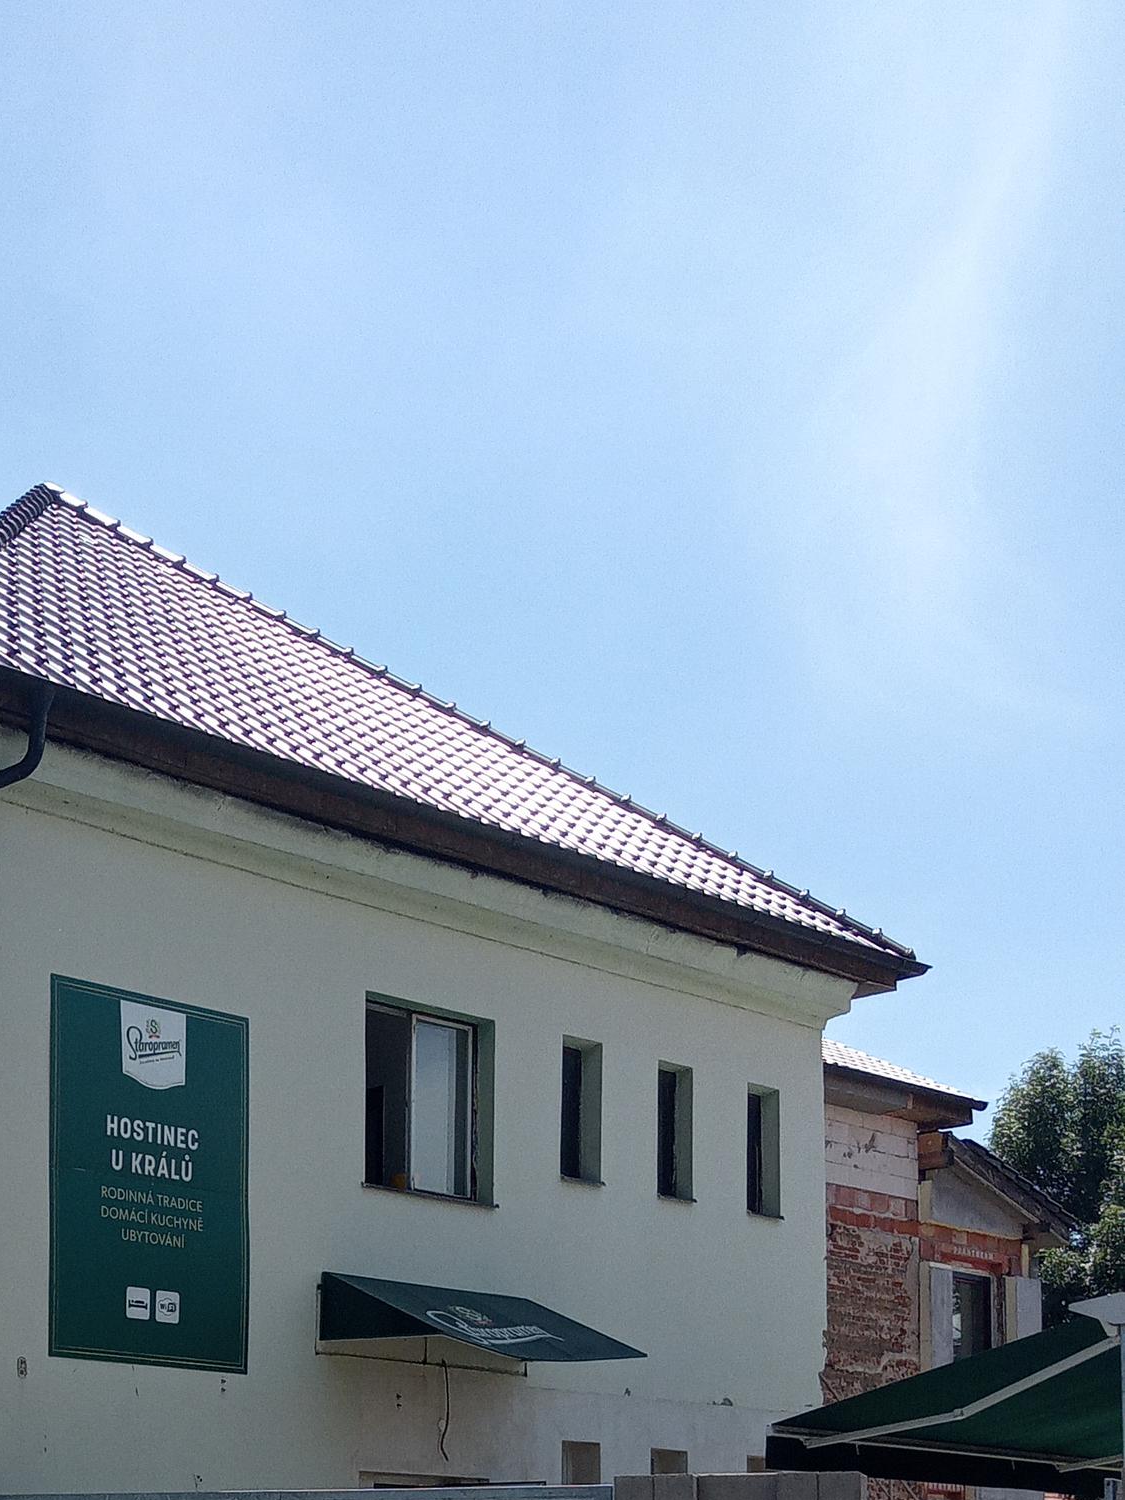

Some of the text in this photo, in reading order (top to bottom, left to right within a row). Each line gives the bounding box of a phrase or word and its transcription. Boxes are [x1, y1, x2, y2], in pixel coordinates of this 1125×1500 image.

[126, 1025, 182, 1061] Staropramen
[106, 1114, 199, 1151] HOSTINEC
[111, 1149, 193, 1182] U KRÁLŮ
[100, 1185, 203, 1213] RODINNÁ TRADICE
[100, 1205, 204, 1232] DOMÁCÍ KUCHYNĚ
[121, 1229, 186, 1248] UBYTOVÁNÍ
